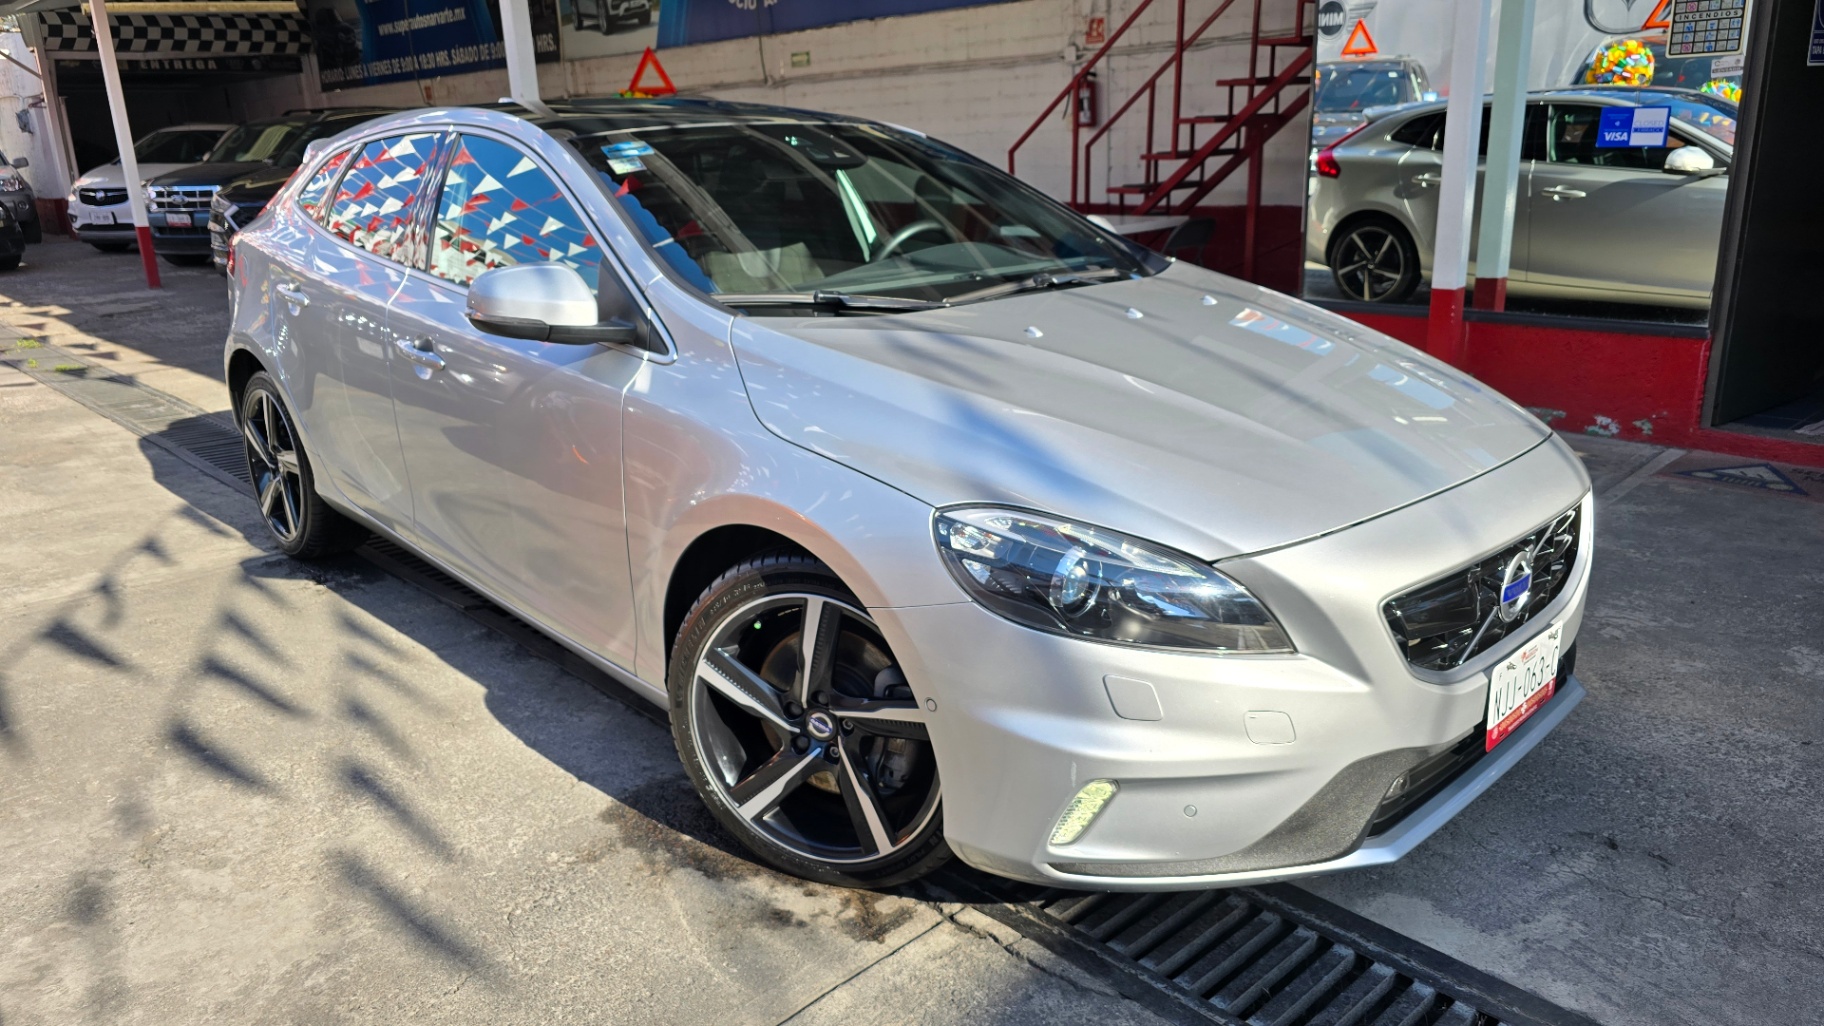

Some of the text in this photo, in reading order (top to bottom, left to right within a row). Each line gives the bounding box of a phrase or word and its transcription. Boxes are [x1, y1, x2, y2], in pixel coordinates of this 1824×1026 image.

[1678, 10, 1739, 20] INCENDIOS
[391, 57, 401, 73] DE
[413, 54, 420, 70] A
[451, 44, 478, 65] SÁBADO
[479, 42, 490, 60] DE
[536, 33, 557, 53] HRS.
[140, 59, 218, 71] ENTREGA
[1603, 131, 1628, 141] VISA
[1493, 645, 1559, 724] NJJ-063-C
